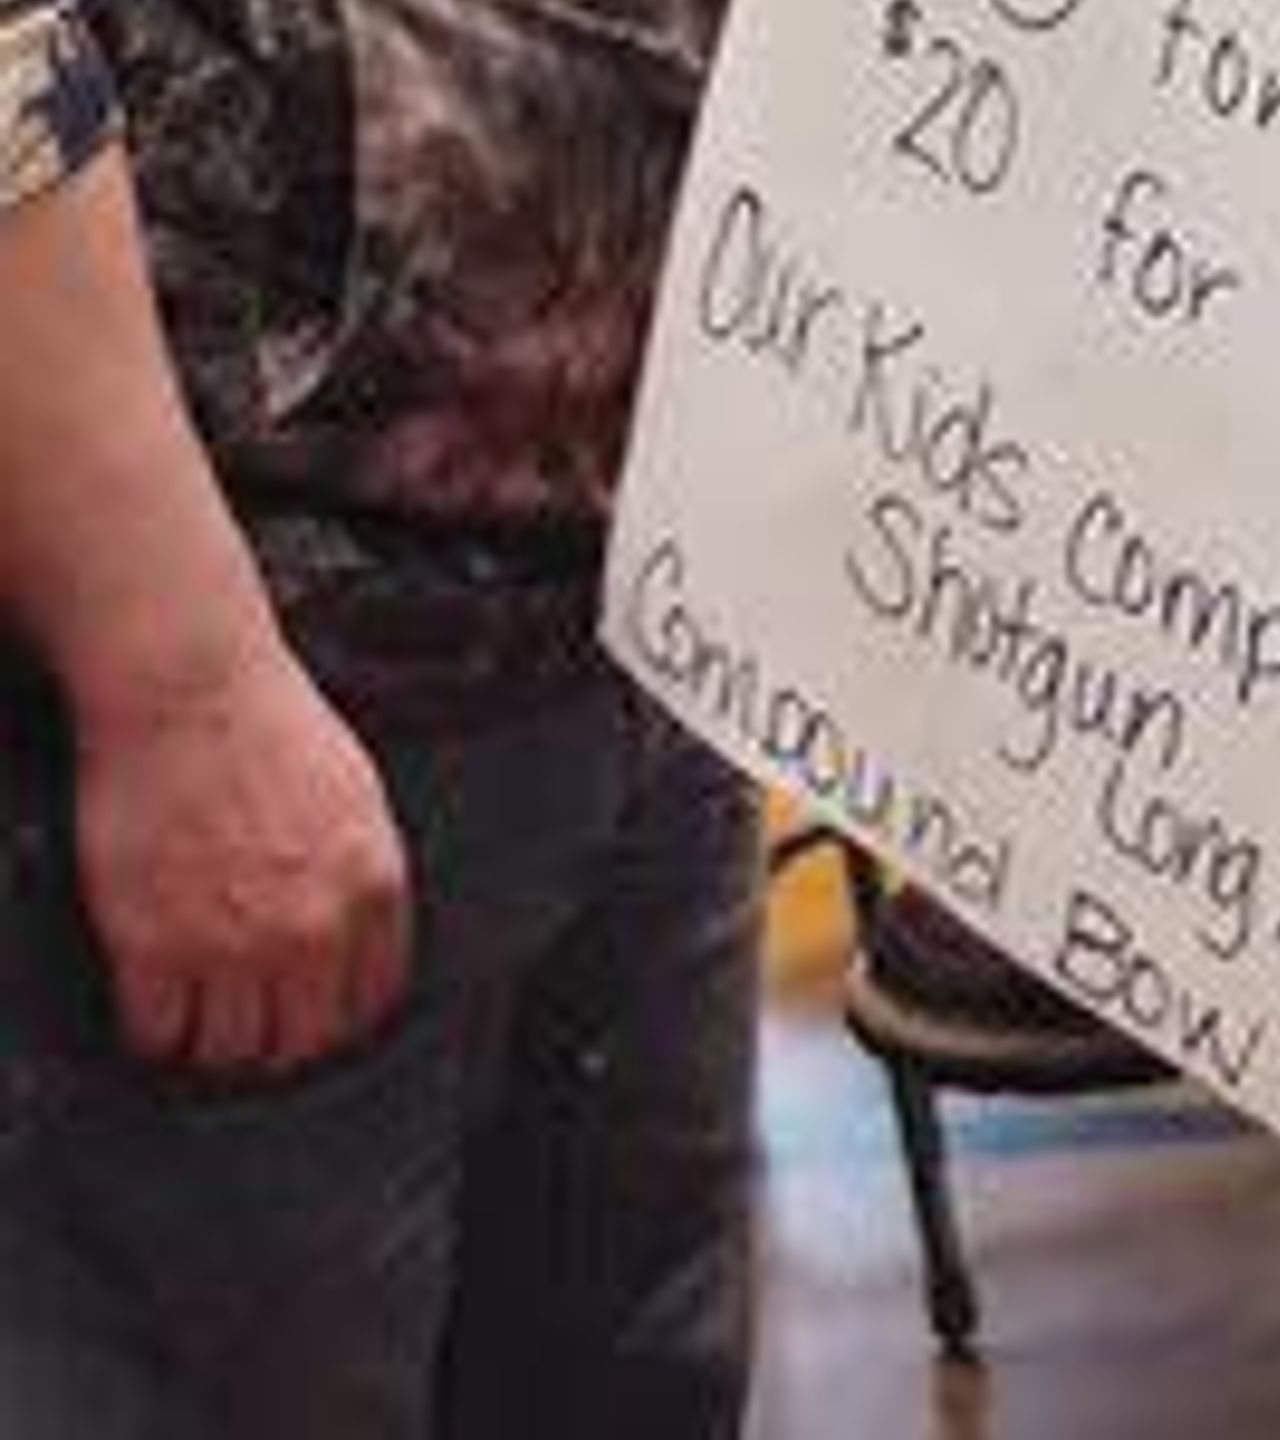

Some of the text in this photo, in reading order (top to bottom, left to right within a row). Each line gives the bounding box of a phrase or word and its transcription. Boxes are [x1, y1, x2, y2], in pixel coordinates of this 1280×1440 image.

[696, 186, 842, 368] Our
[1092, 168, 1240, 324] for
[842, 492, 1188, 774] Shotgun
